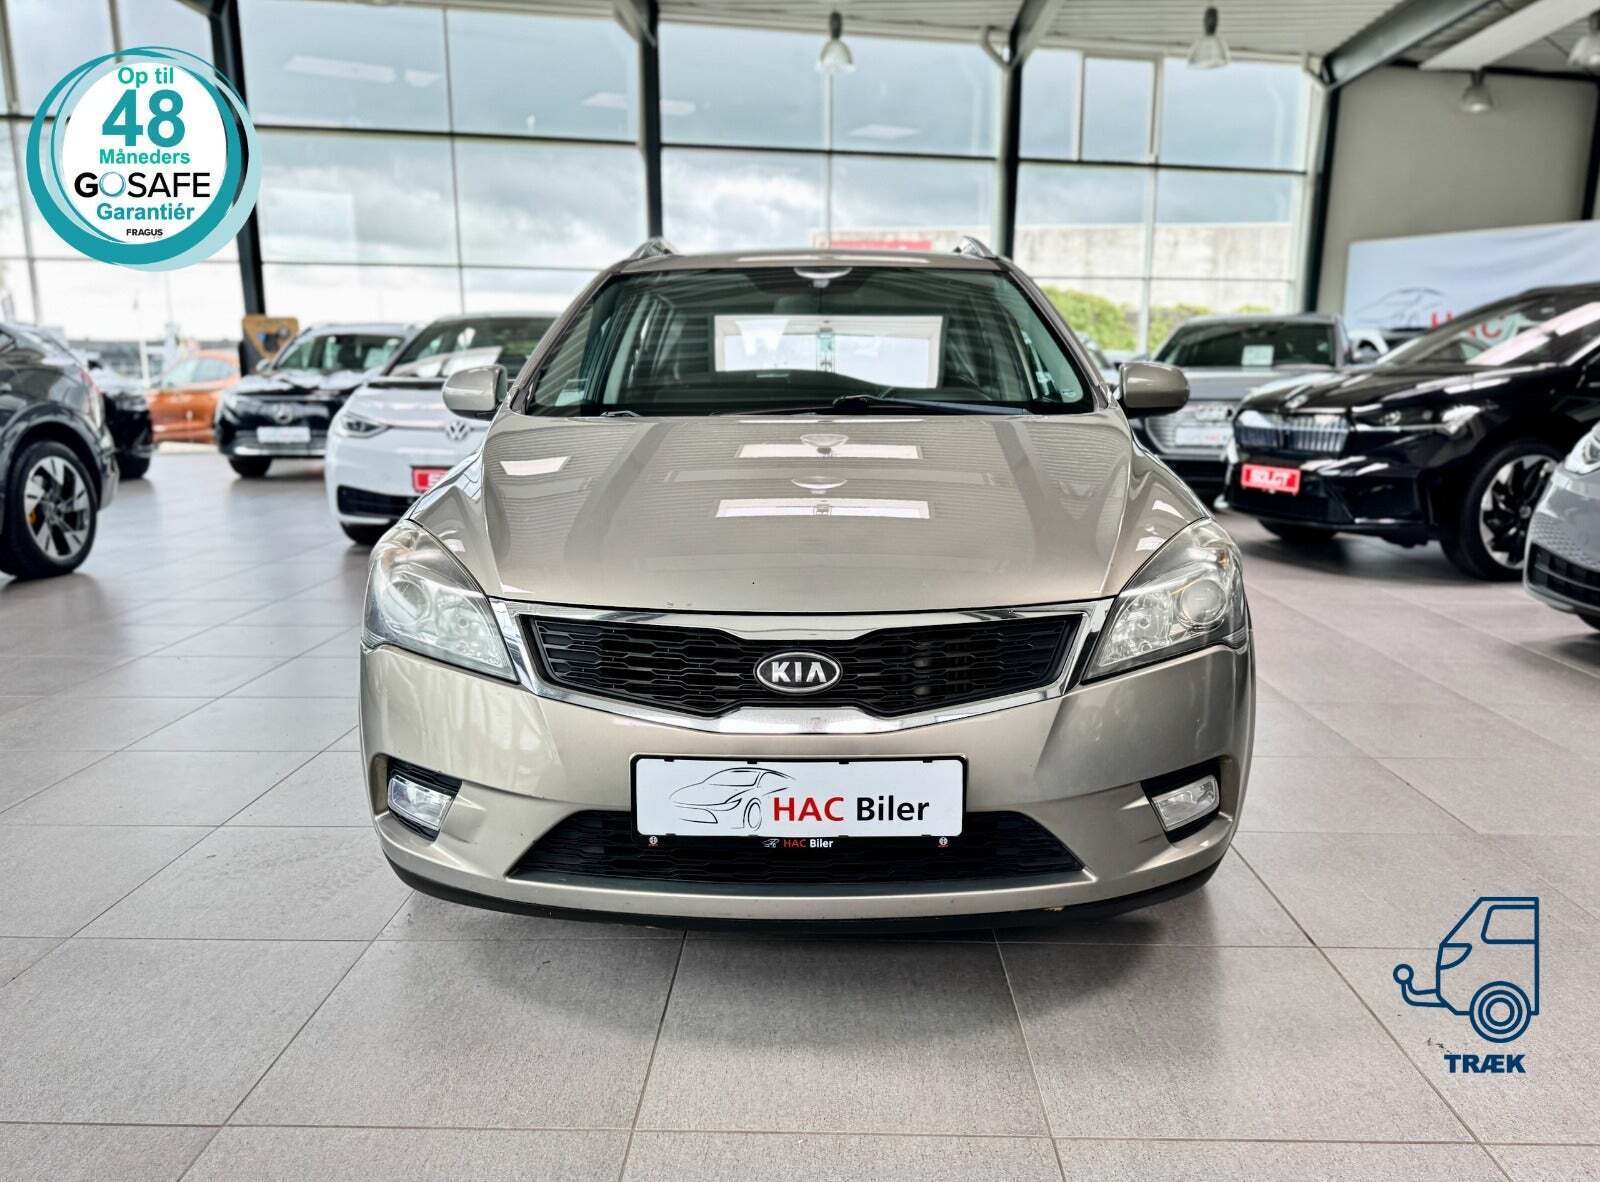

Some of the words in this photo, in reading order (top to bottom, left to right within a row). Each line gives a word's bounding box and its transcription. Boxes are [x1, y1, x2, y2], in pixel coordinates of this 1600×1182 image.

[771, 661, 827, 682] KIA
[773, 796, 844, 821] HAC
[856, 796, 930, 821] Biler
[783, 838, 806, 848] HAC
[809, 838, 834, 848] Biler
